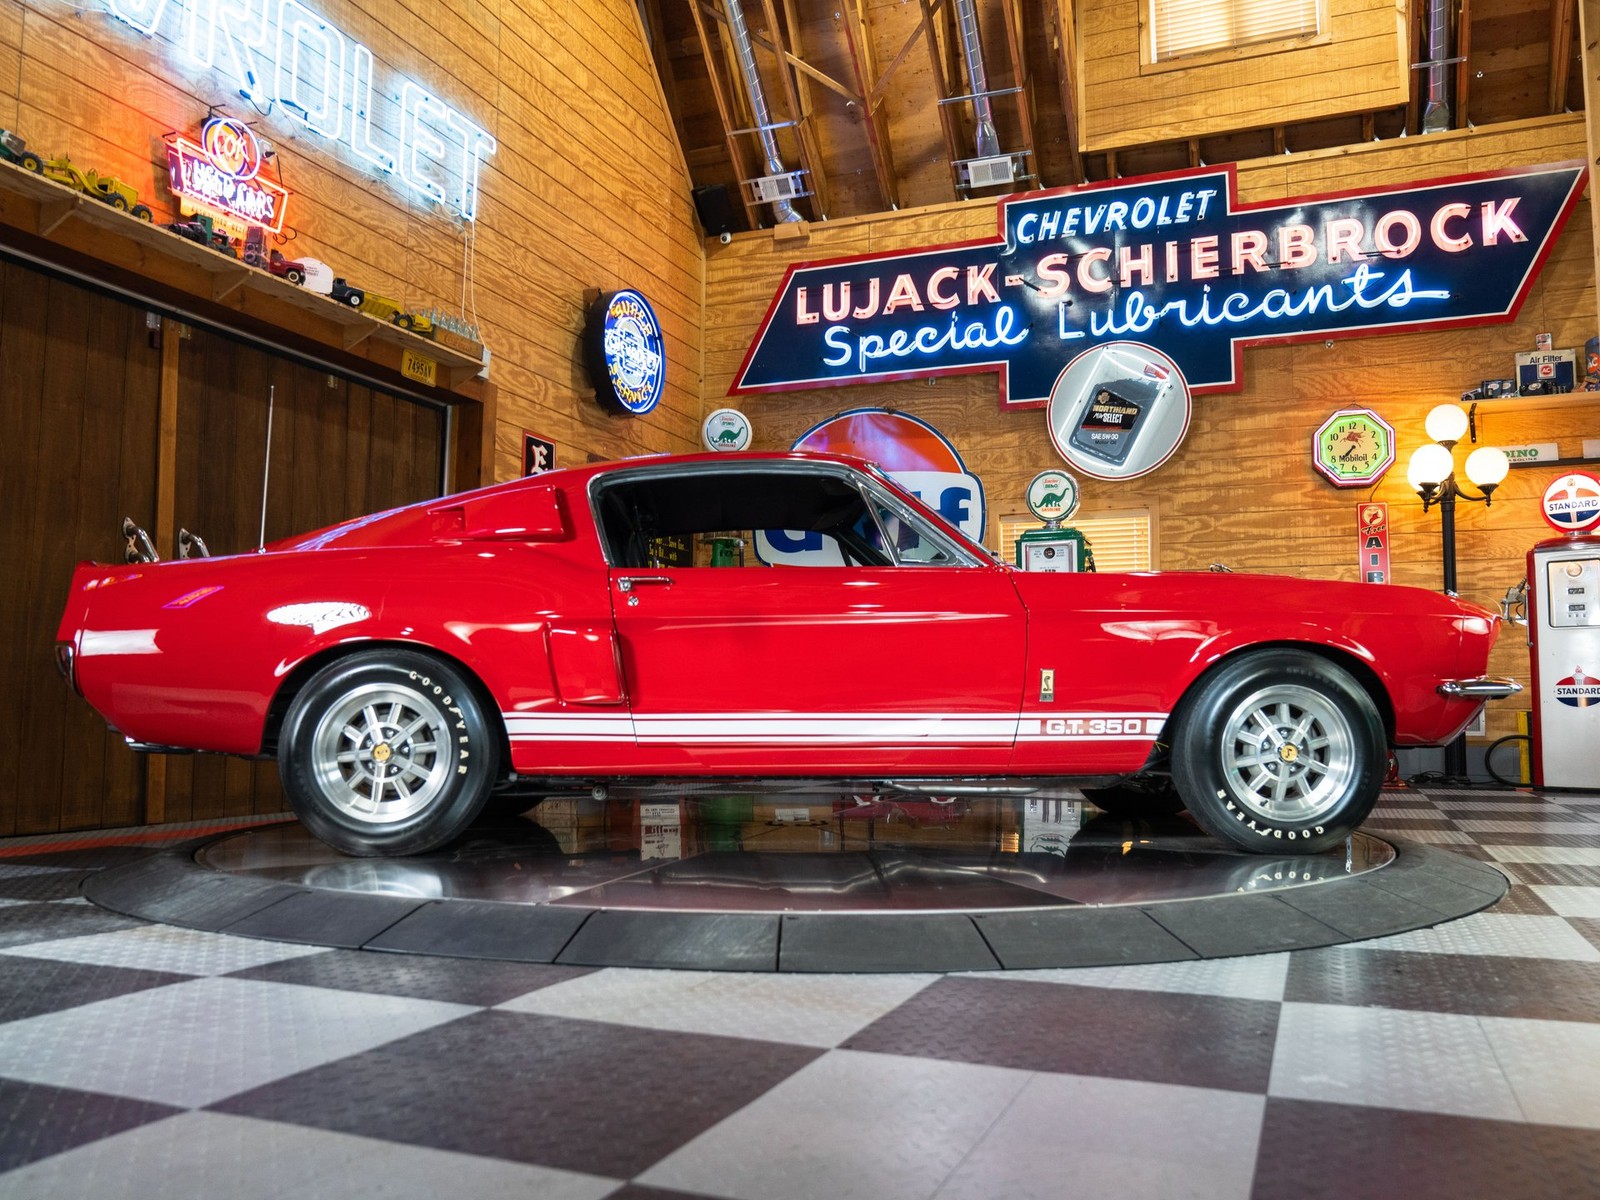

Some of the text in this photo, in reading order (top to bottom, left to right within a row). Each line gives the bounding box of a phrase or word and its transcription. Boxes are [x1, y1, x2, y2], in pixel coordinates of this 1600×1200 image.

[1016, 190, 1217, 244] CHEVROLET
[822, 263, 1451, 372] Special Lubricants
[1529, 354, 1563, 364] Air Filter
[1587, 356, 1599, 368] AC
[1092, 404, 1138, 415] NORTHLAND
[1102, 412, 1123, 424] SELECT
[1549, 499, 1598, 512] STANDARD
[1361, 524, 1387, 535] Free
[409, 670, 469, 775] GOODYEAR
[1088, 719, 1142, 734] 350
[1216, 788, 1325, 840] GOODYEAR
